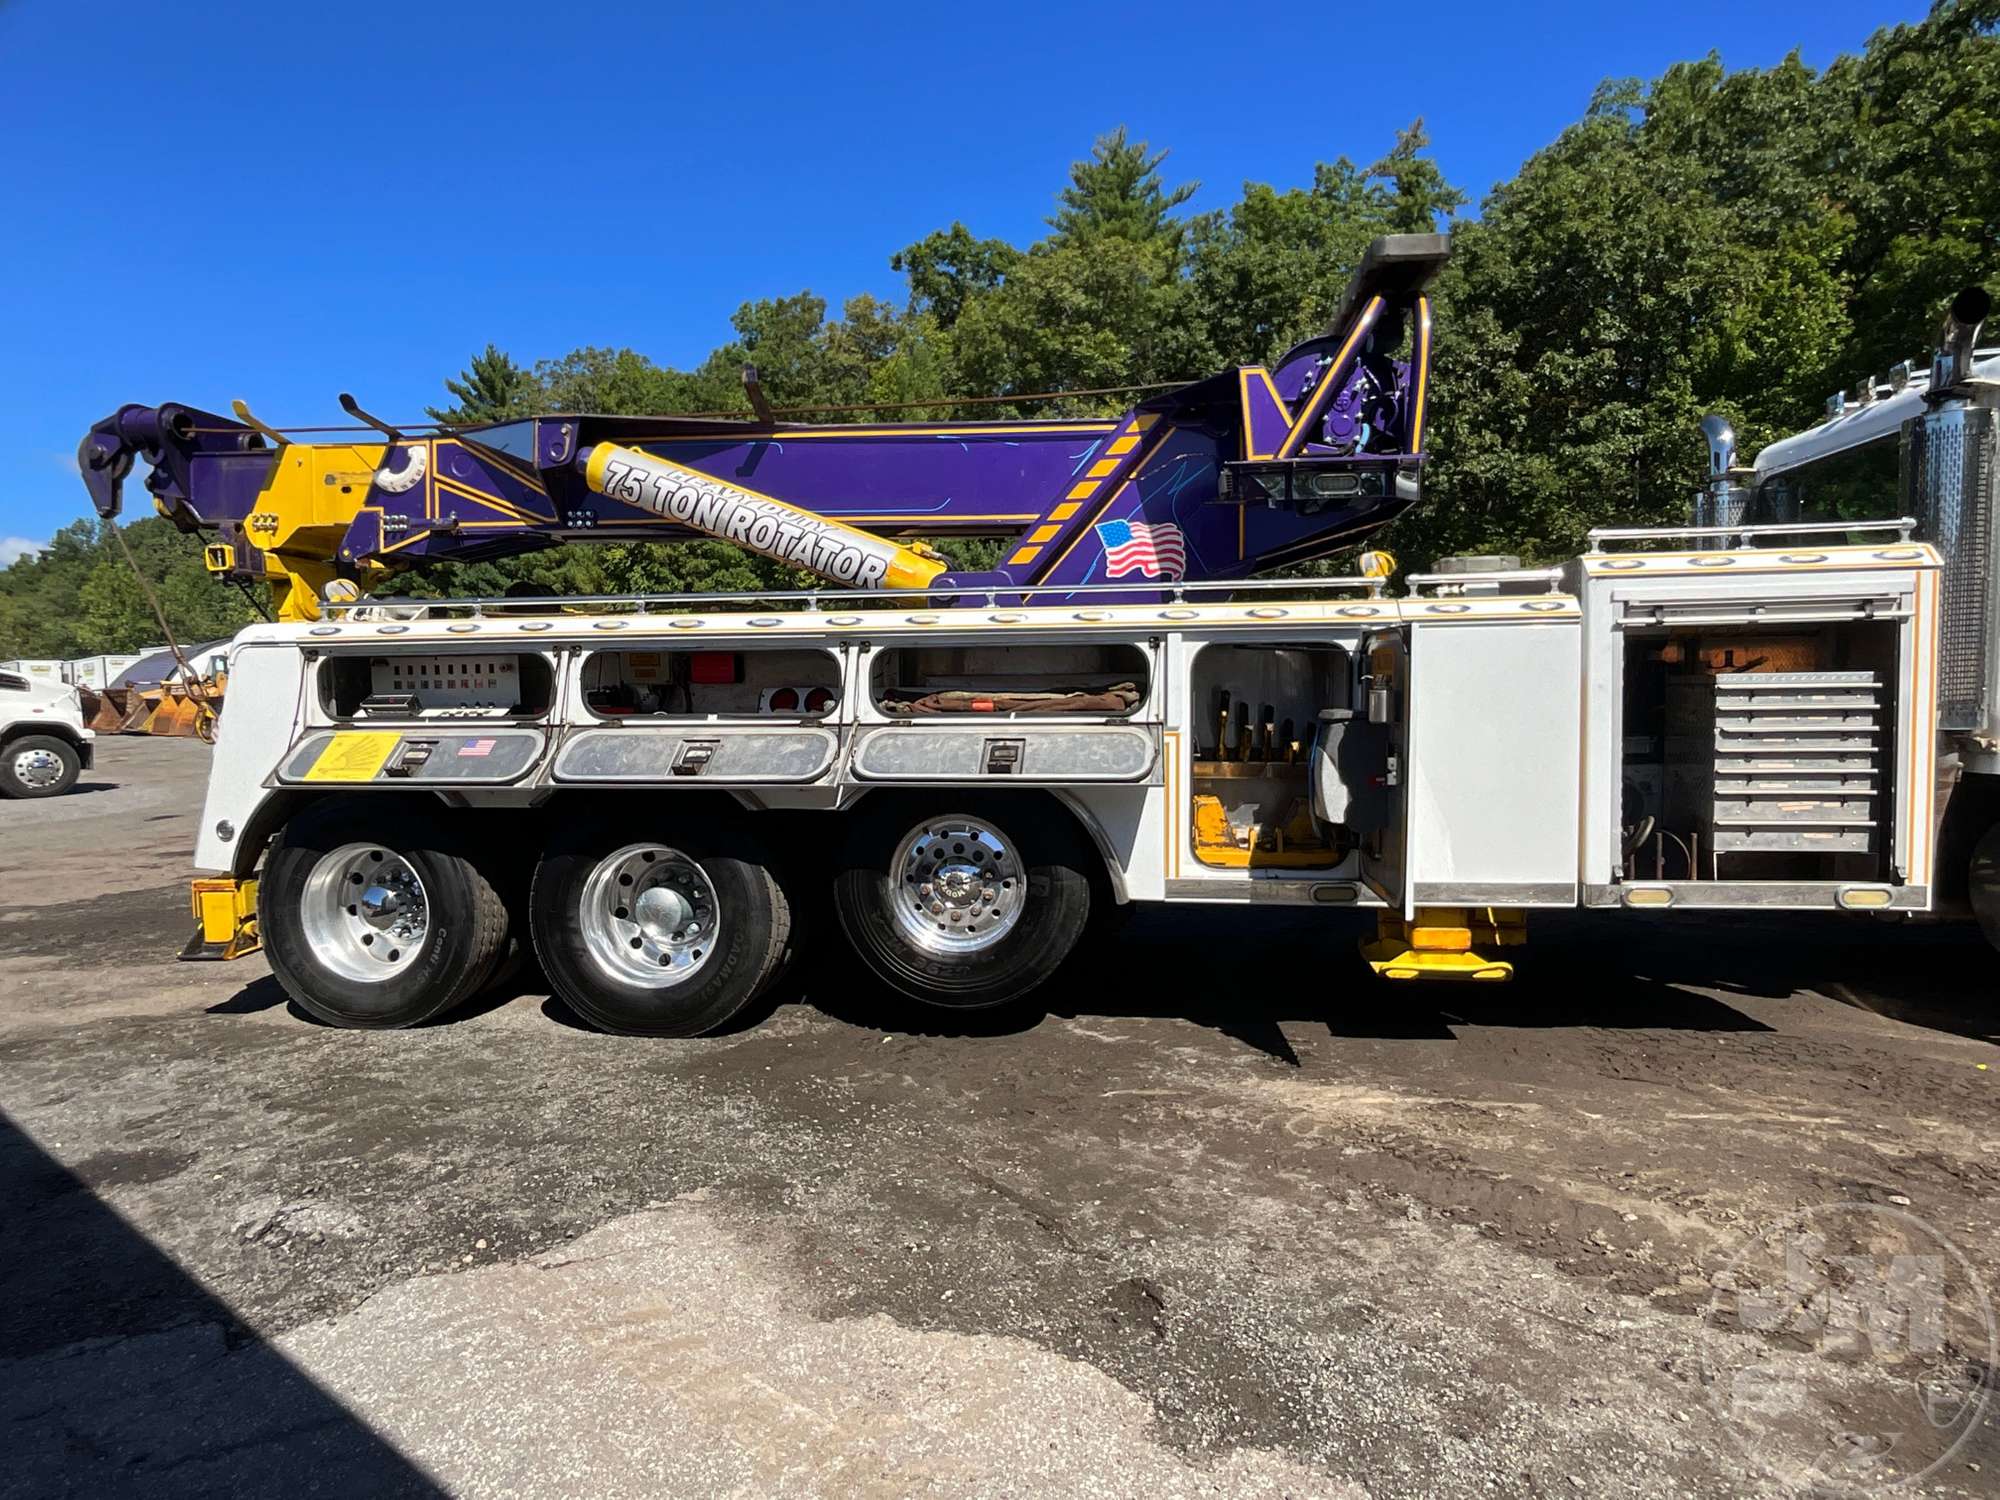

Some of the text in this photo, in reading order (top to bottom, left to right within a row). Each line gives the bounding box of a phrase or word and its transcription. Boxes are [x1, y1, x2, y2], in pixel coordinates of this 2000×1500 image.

[605, 460, 888, 591] 75 TON ROTATOR
[666, 469, 838, 534] HEAVY DUTY
